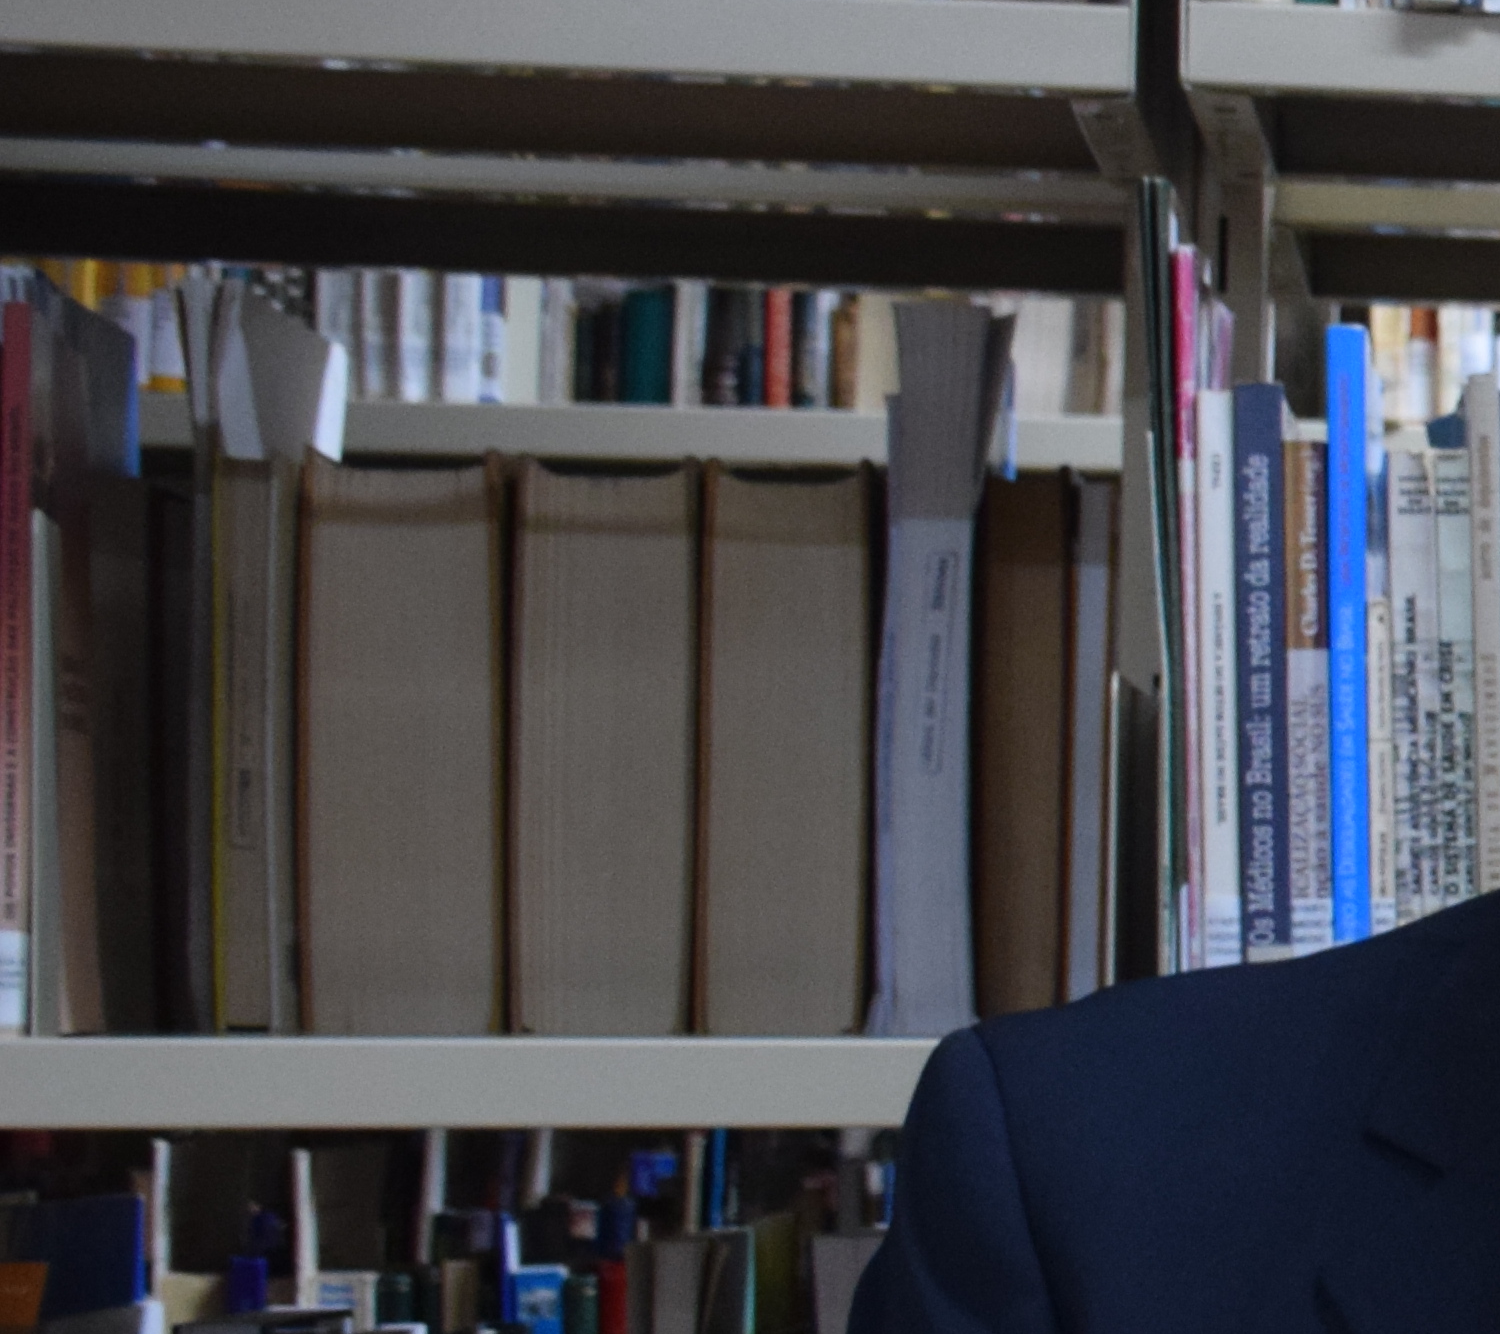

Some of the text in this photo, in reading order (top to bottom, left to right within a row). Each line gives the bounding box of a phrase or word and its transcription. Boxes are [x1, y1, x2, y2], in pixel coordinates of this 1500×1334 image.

[1242, 454, 1274, 945] Os Médicos no Brasil: um retrato da realidade
[1290, 772, 1312, 899] ICALIZAÇÃO
